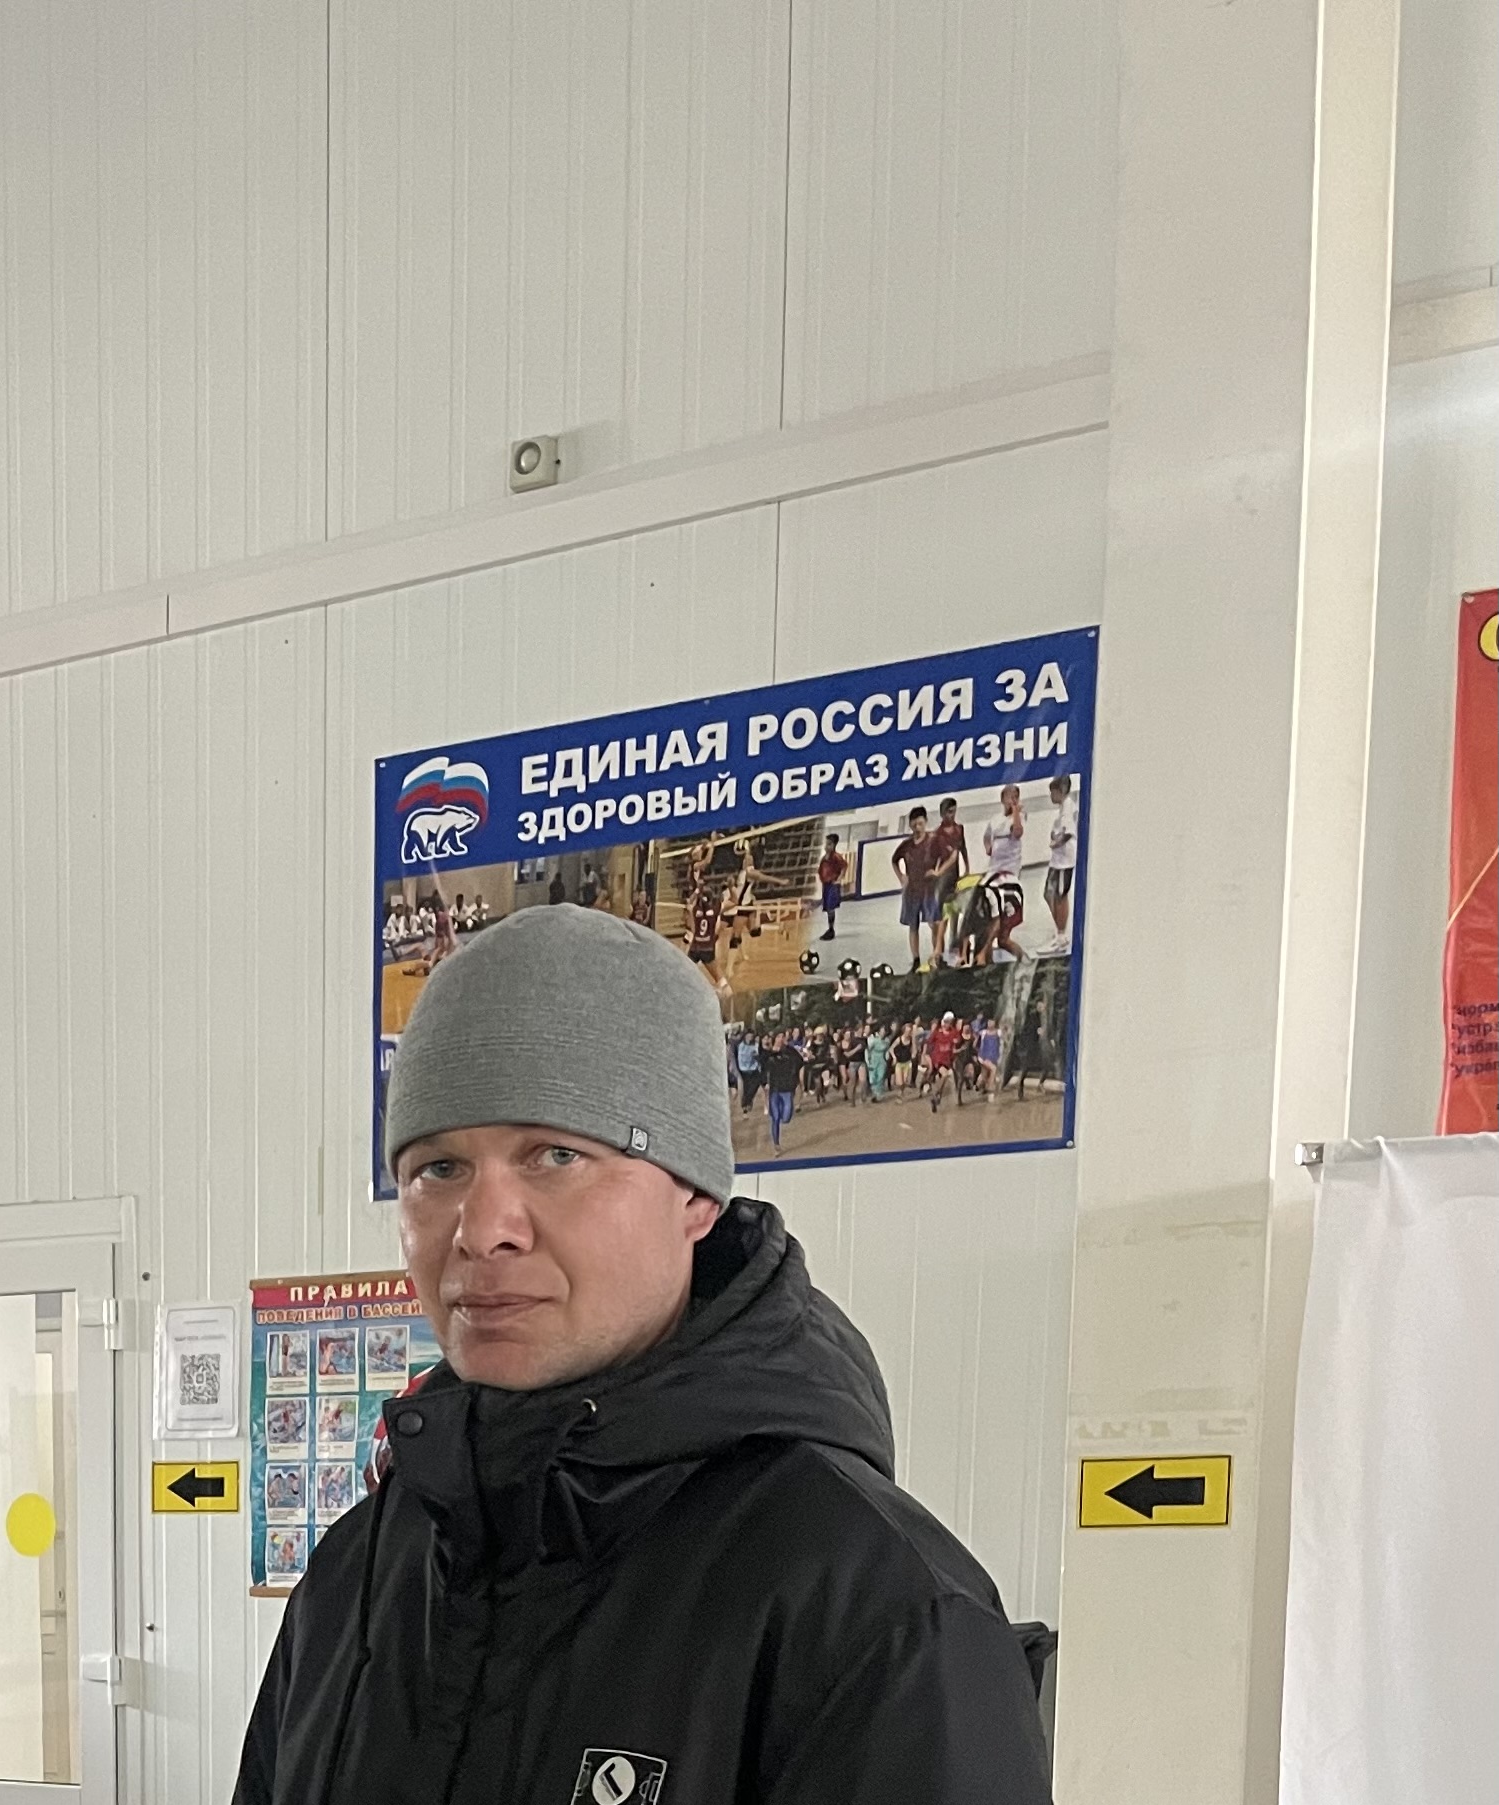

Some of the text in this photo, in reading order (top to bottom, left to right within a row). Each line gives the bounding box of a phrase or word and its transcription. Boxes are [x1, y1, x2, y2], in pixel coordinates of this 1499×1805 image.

[521, 662, 1069, 797] ЕДИНАЯ РОССИЯ ЗА
[517, 721, 1068, 844] ЗДОРОВЫЙ ОБРАЗ ЖИЗНИ
[290, 1280, 408, 1302] ПРАВИЛА
[347, 1305, 358, 1319] В
